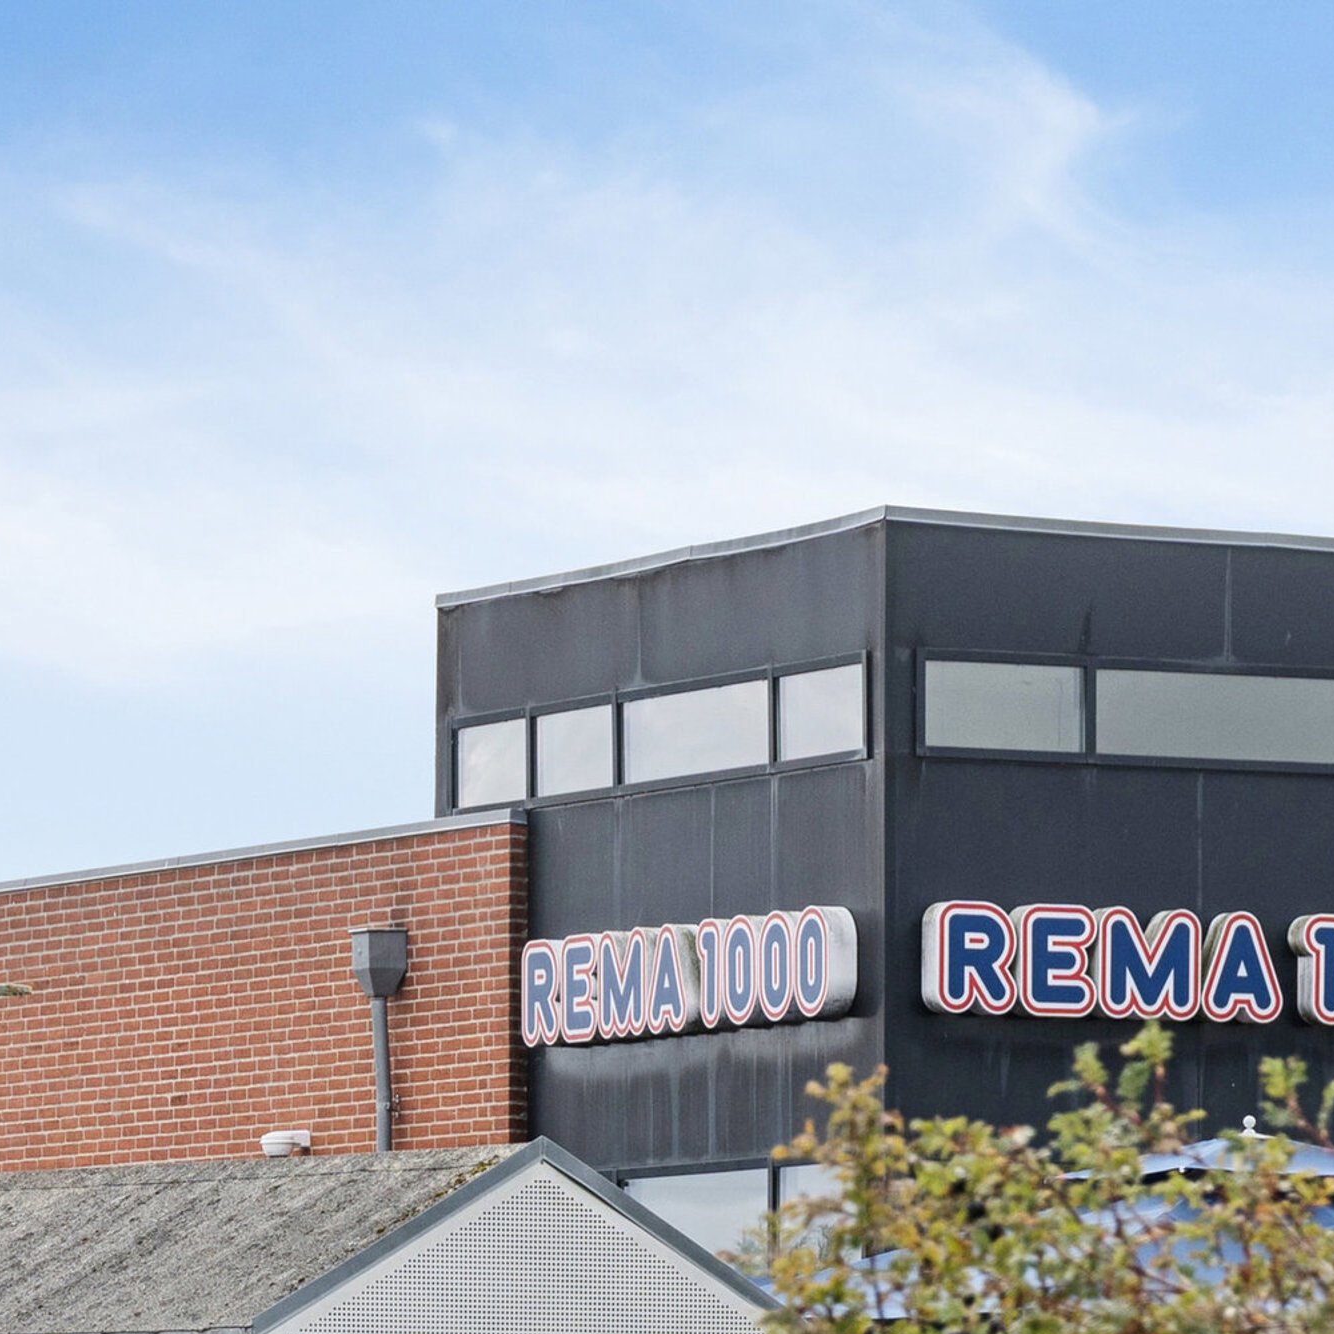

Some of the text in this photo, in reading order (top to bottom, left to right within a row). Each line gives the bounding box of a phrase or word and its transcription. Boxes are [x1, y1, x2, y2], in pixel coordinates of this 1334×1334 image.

[522, 905, 829, 1046] REMA 1000
[939, 901, 1283, 1024] REMA
